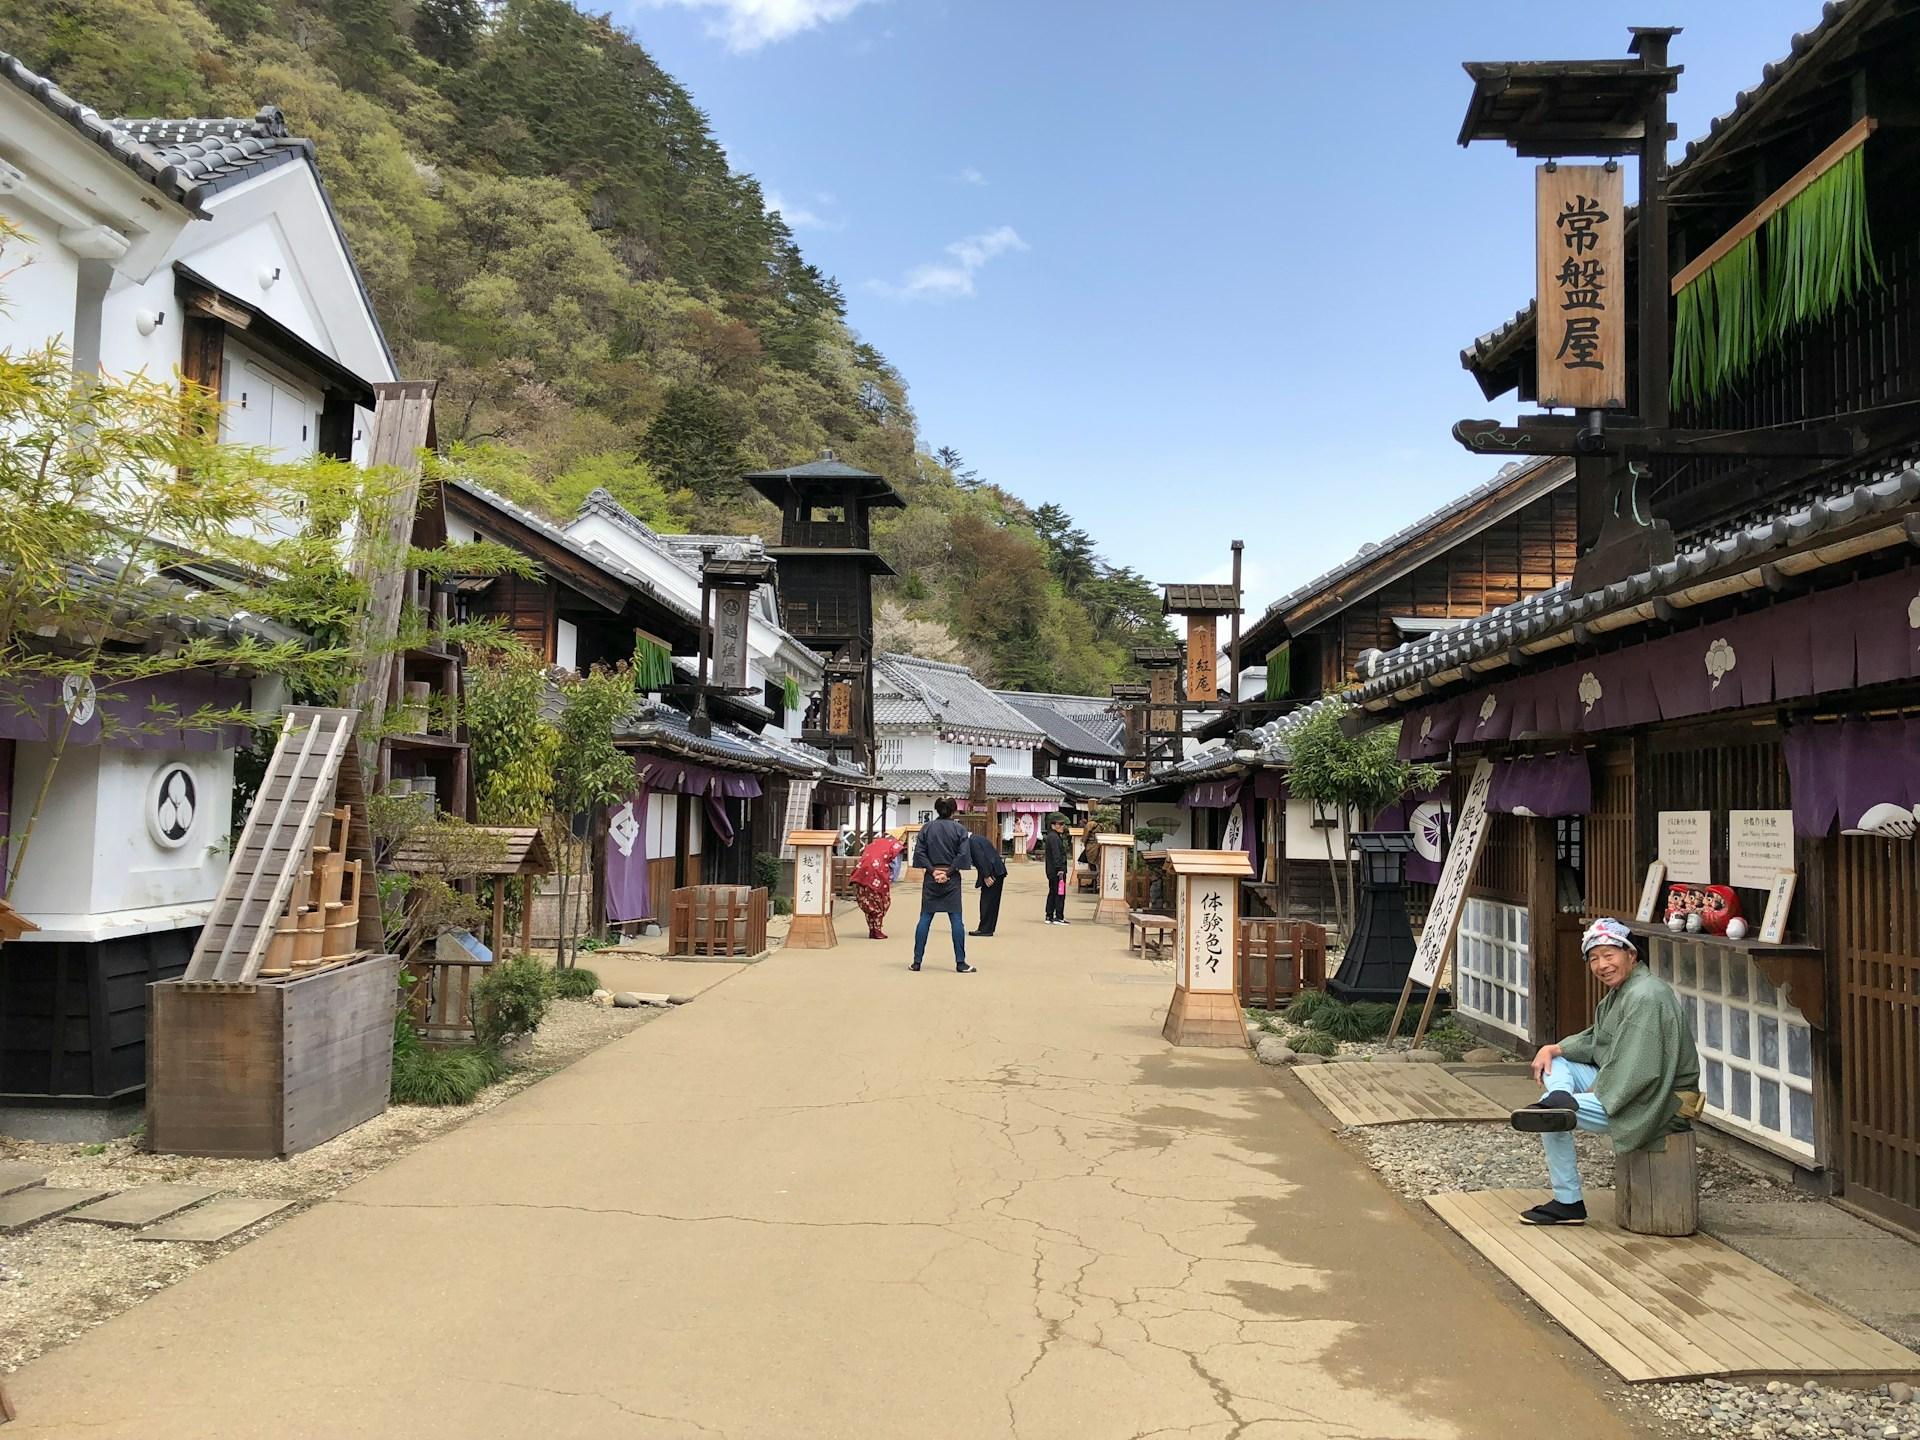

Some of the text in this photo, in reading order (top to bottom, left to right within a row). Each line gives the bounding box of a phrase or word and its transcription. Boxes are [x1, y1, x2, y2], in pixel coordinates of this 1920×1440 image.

[1556, 195, 1609, 371] 常盤屋
[721, 624, 738, 677] 越後屋
[1195, 658, 1212, 693] 紅庵
[1200, 890, 1224, 975] 体験色々
